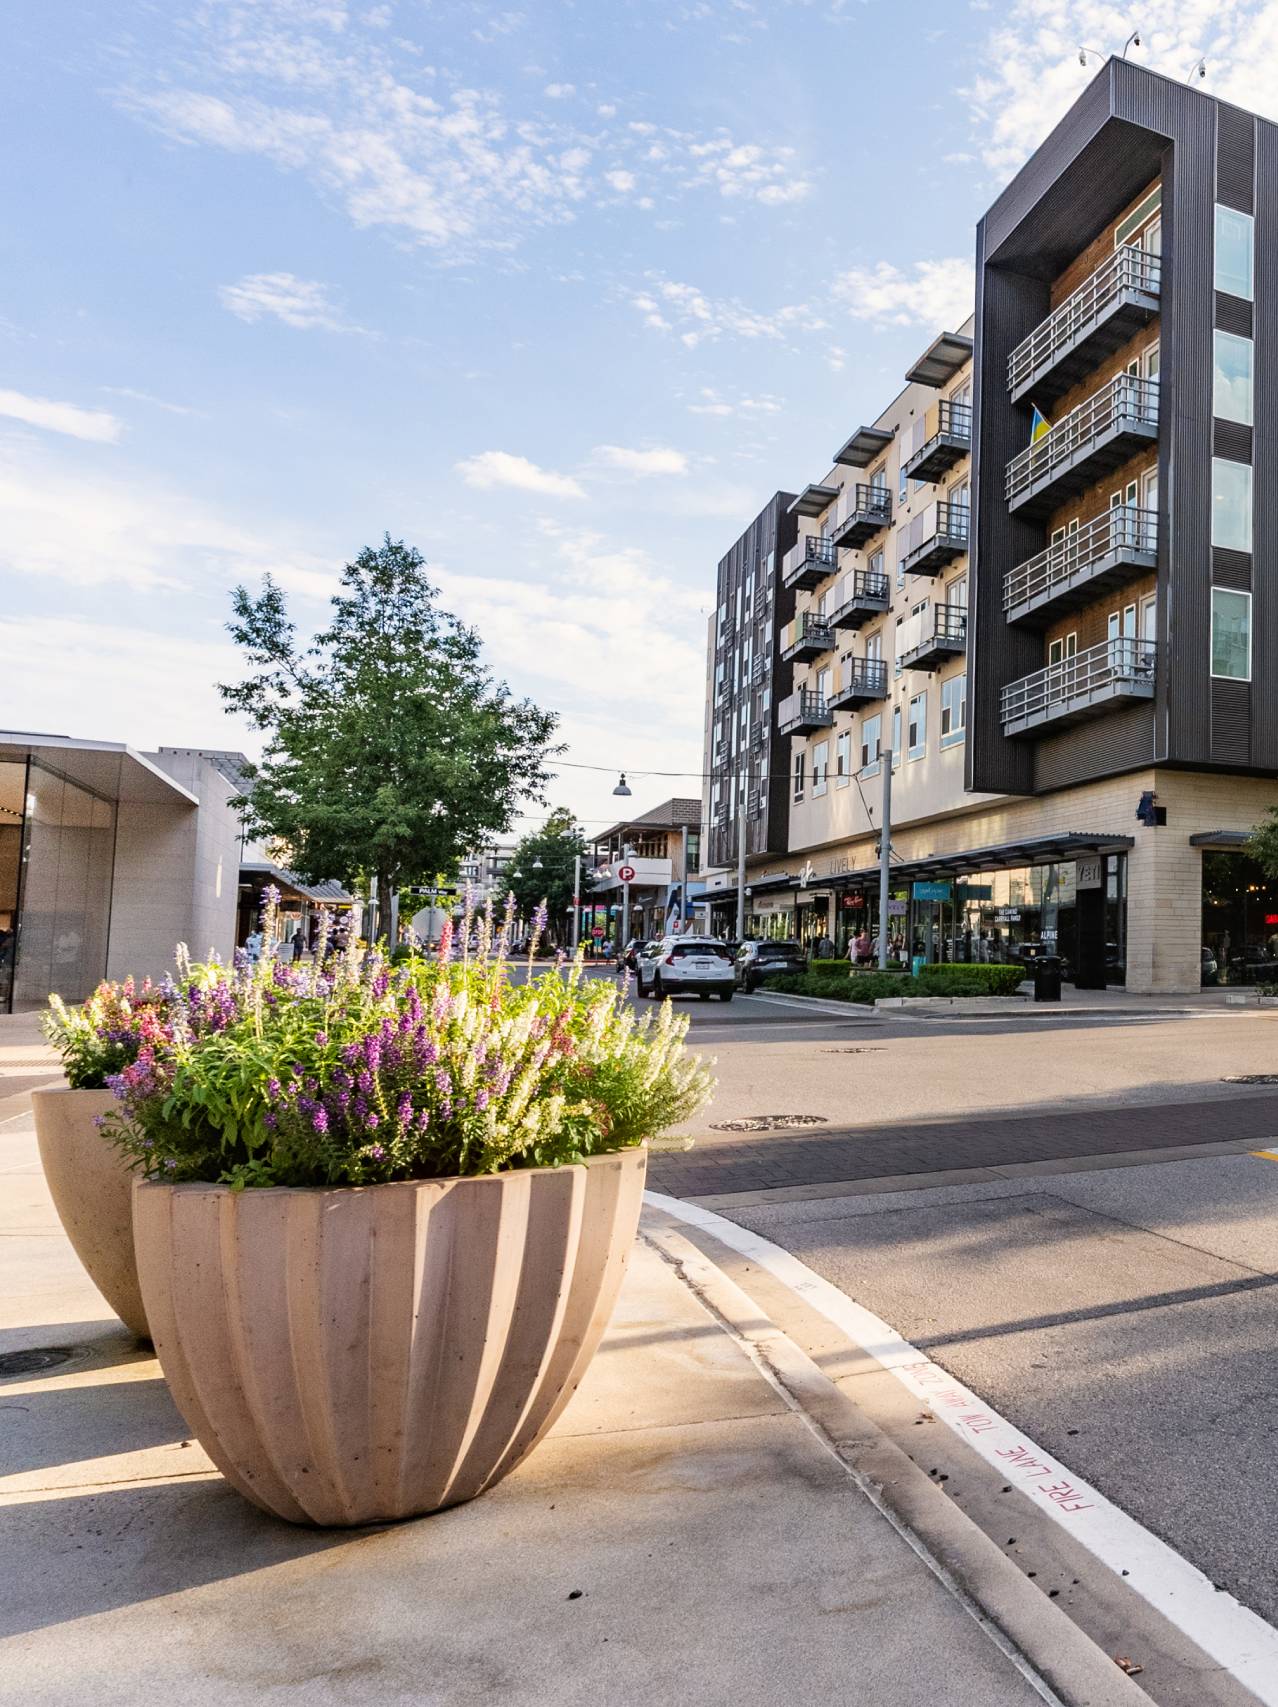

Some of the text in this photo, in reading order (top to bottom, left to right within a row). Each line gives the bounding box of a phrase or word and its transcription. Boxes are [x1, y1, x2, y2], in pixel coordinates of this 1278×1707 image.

[622, 868, 632, 879] P
[830, 855, 857, 875] LIVELY
[1078, 863, 1100, 881] YETI
[592, 928, 604, 936] STOP
[1040, 930, 1058, 940] ALPINE
[935, 1389, 968, 1408] AWAY
[958, 1413, 998, 1434] TOW
[995, 1445, 1053, 1478] LANE
[1038, 1481, 1095, 1512] FIRE
